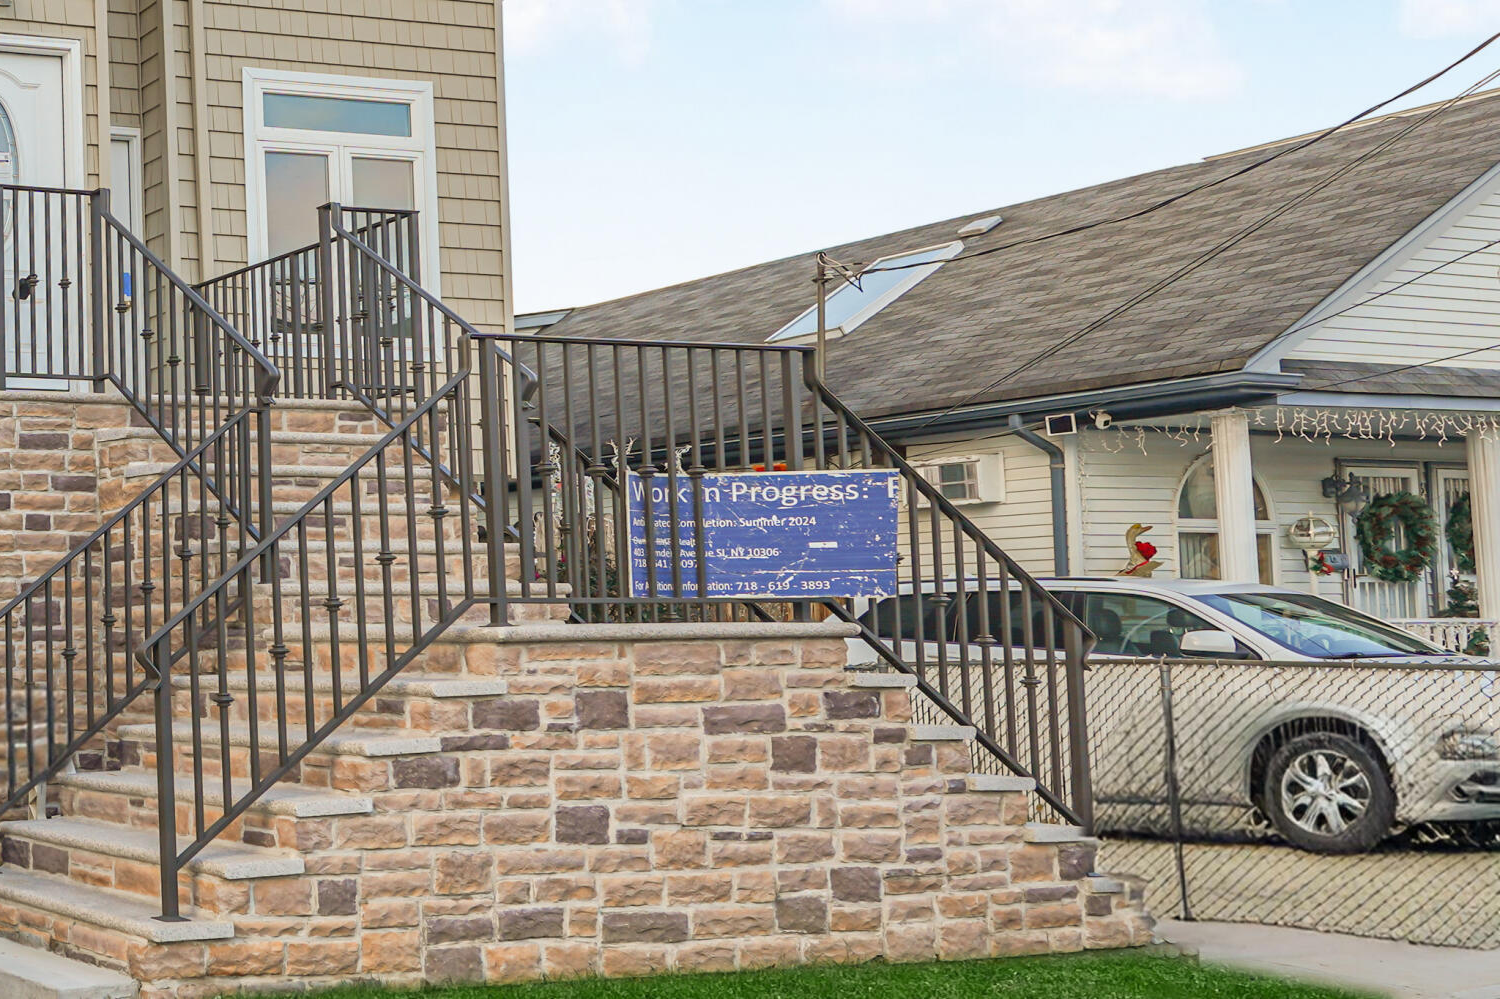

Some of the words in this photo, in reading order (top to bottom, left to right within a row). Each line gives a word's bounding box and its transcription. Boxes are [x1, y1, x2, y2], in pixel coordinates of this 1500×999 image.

[632, 480, 688, 503] Work
[731, 481, 869, 506] Progress:
[739, 517, 786, 528] Summer
[788, 516, 816, 527] 2024
[680, 548, 716, 558] Aveue
[731, 548, 745, 557] NY
[748, 547, 780, 557] 10306
[634, 559, 647, 568] 718
[736, 581, 758, 591] 718
[767, 581, 790, 591] 619
[801, 580, 831, 590] 3893
